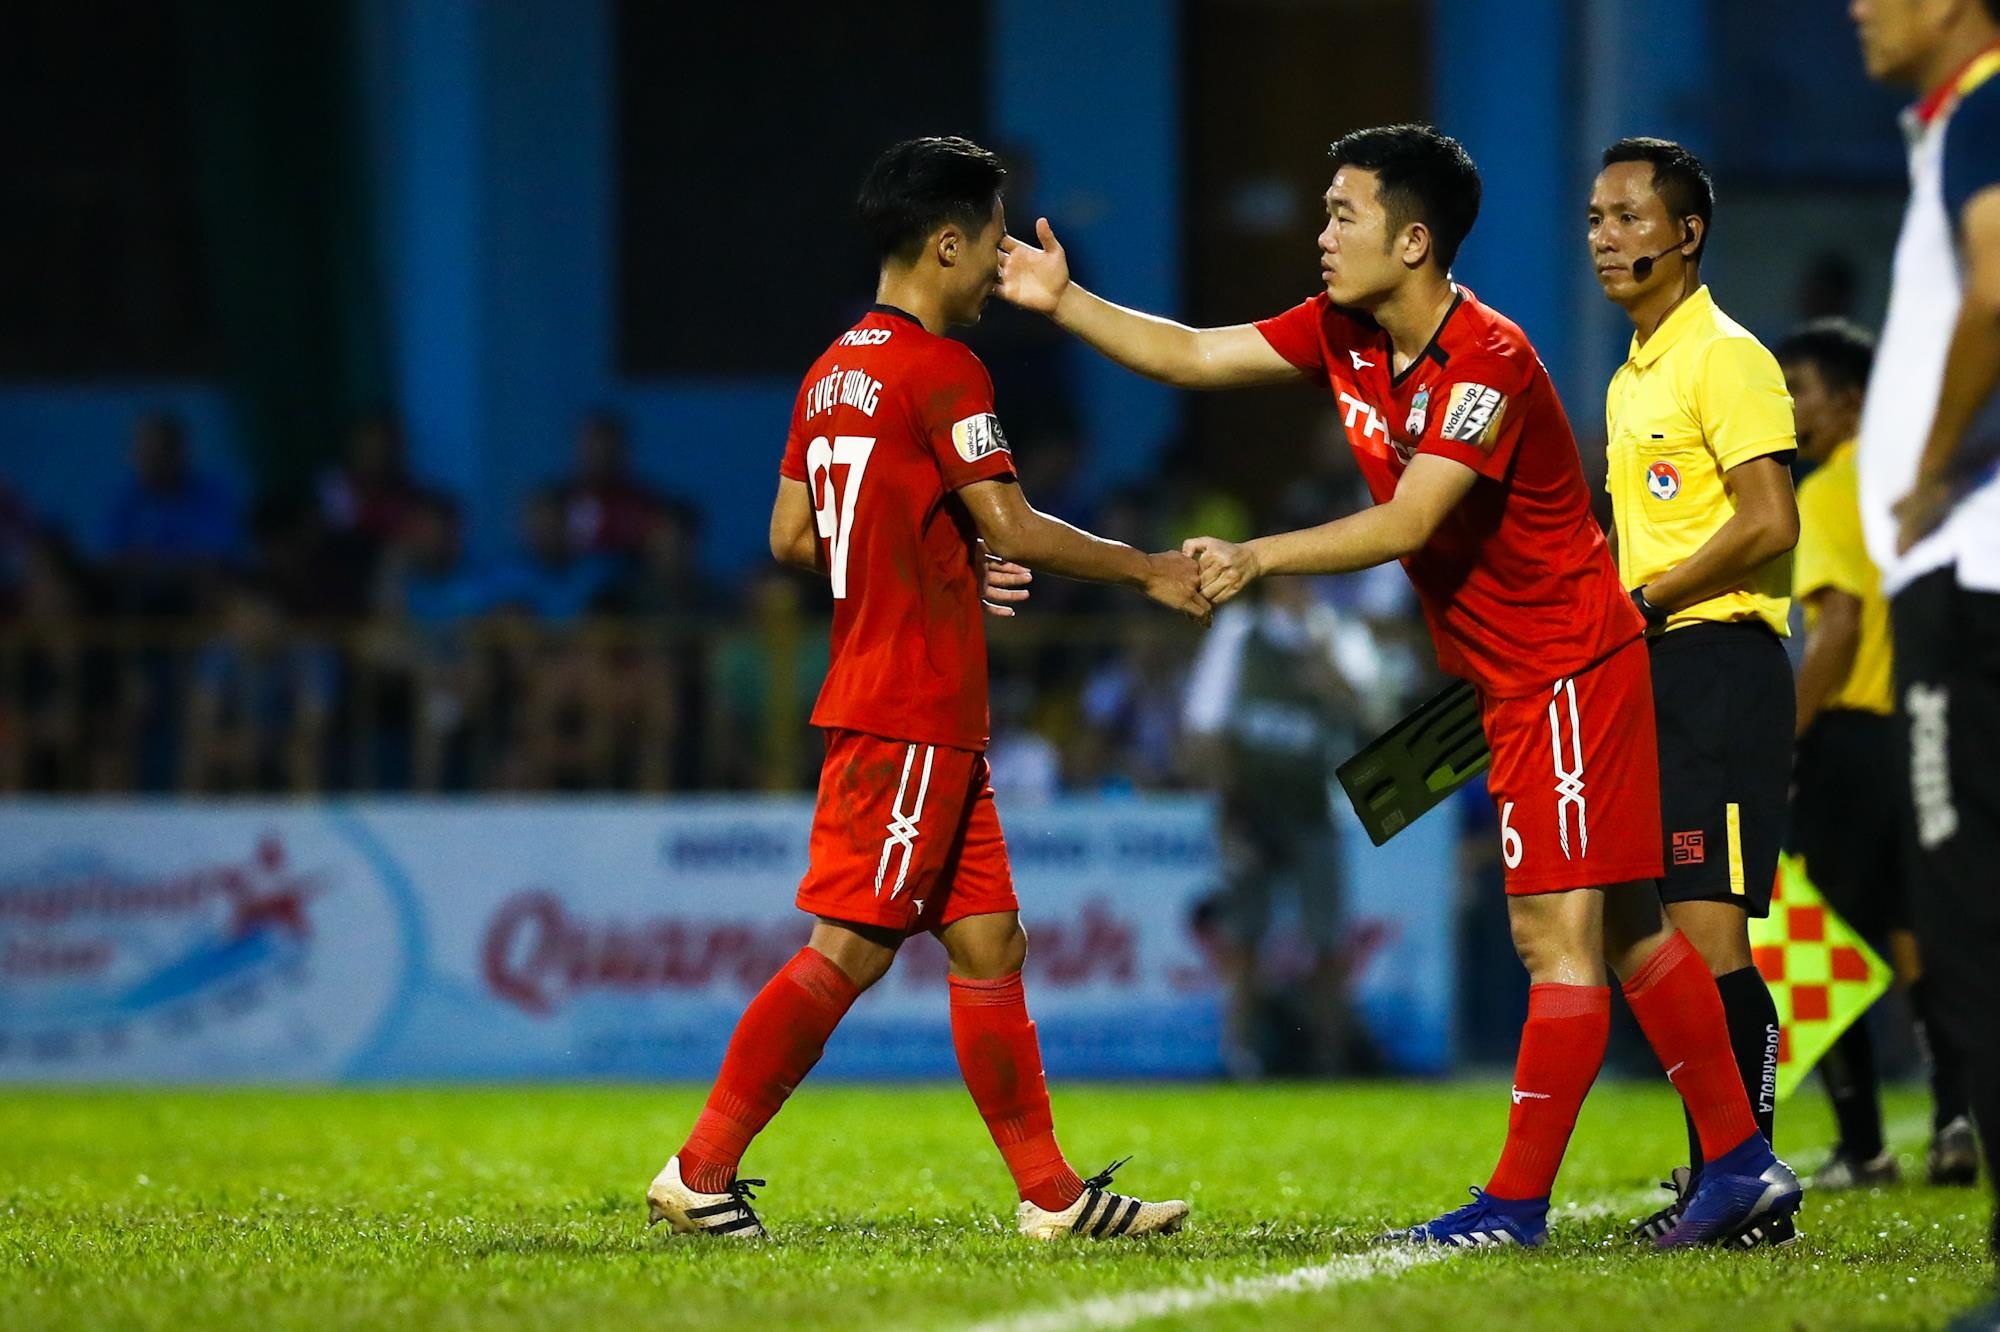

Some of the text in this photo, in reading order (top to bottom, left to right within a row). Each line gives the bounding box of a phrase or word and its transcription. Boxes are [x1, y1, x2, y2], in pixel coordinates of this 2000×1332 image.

[839, 328, 892, 346] THACO
[806, 436, 877, 599] 97
[1501, 802, 1523, 870] 6
[1759, 1023, 1780, 1113] JOGARBOLA
